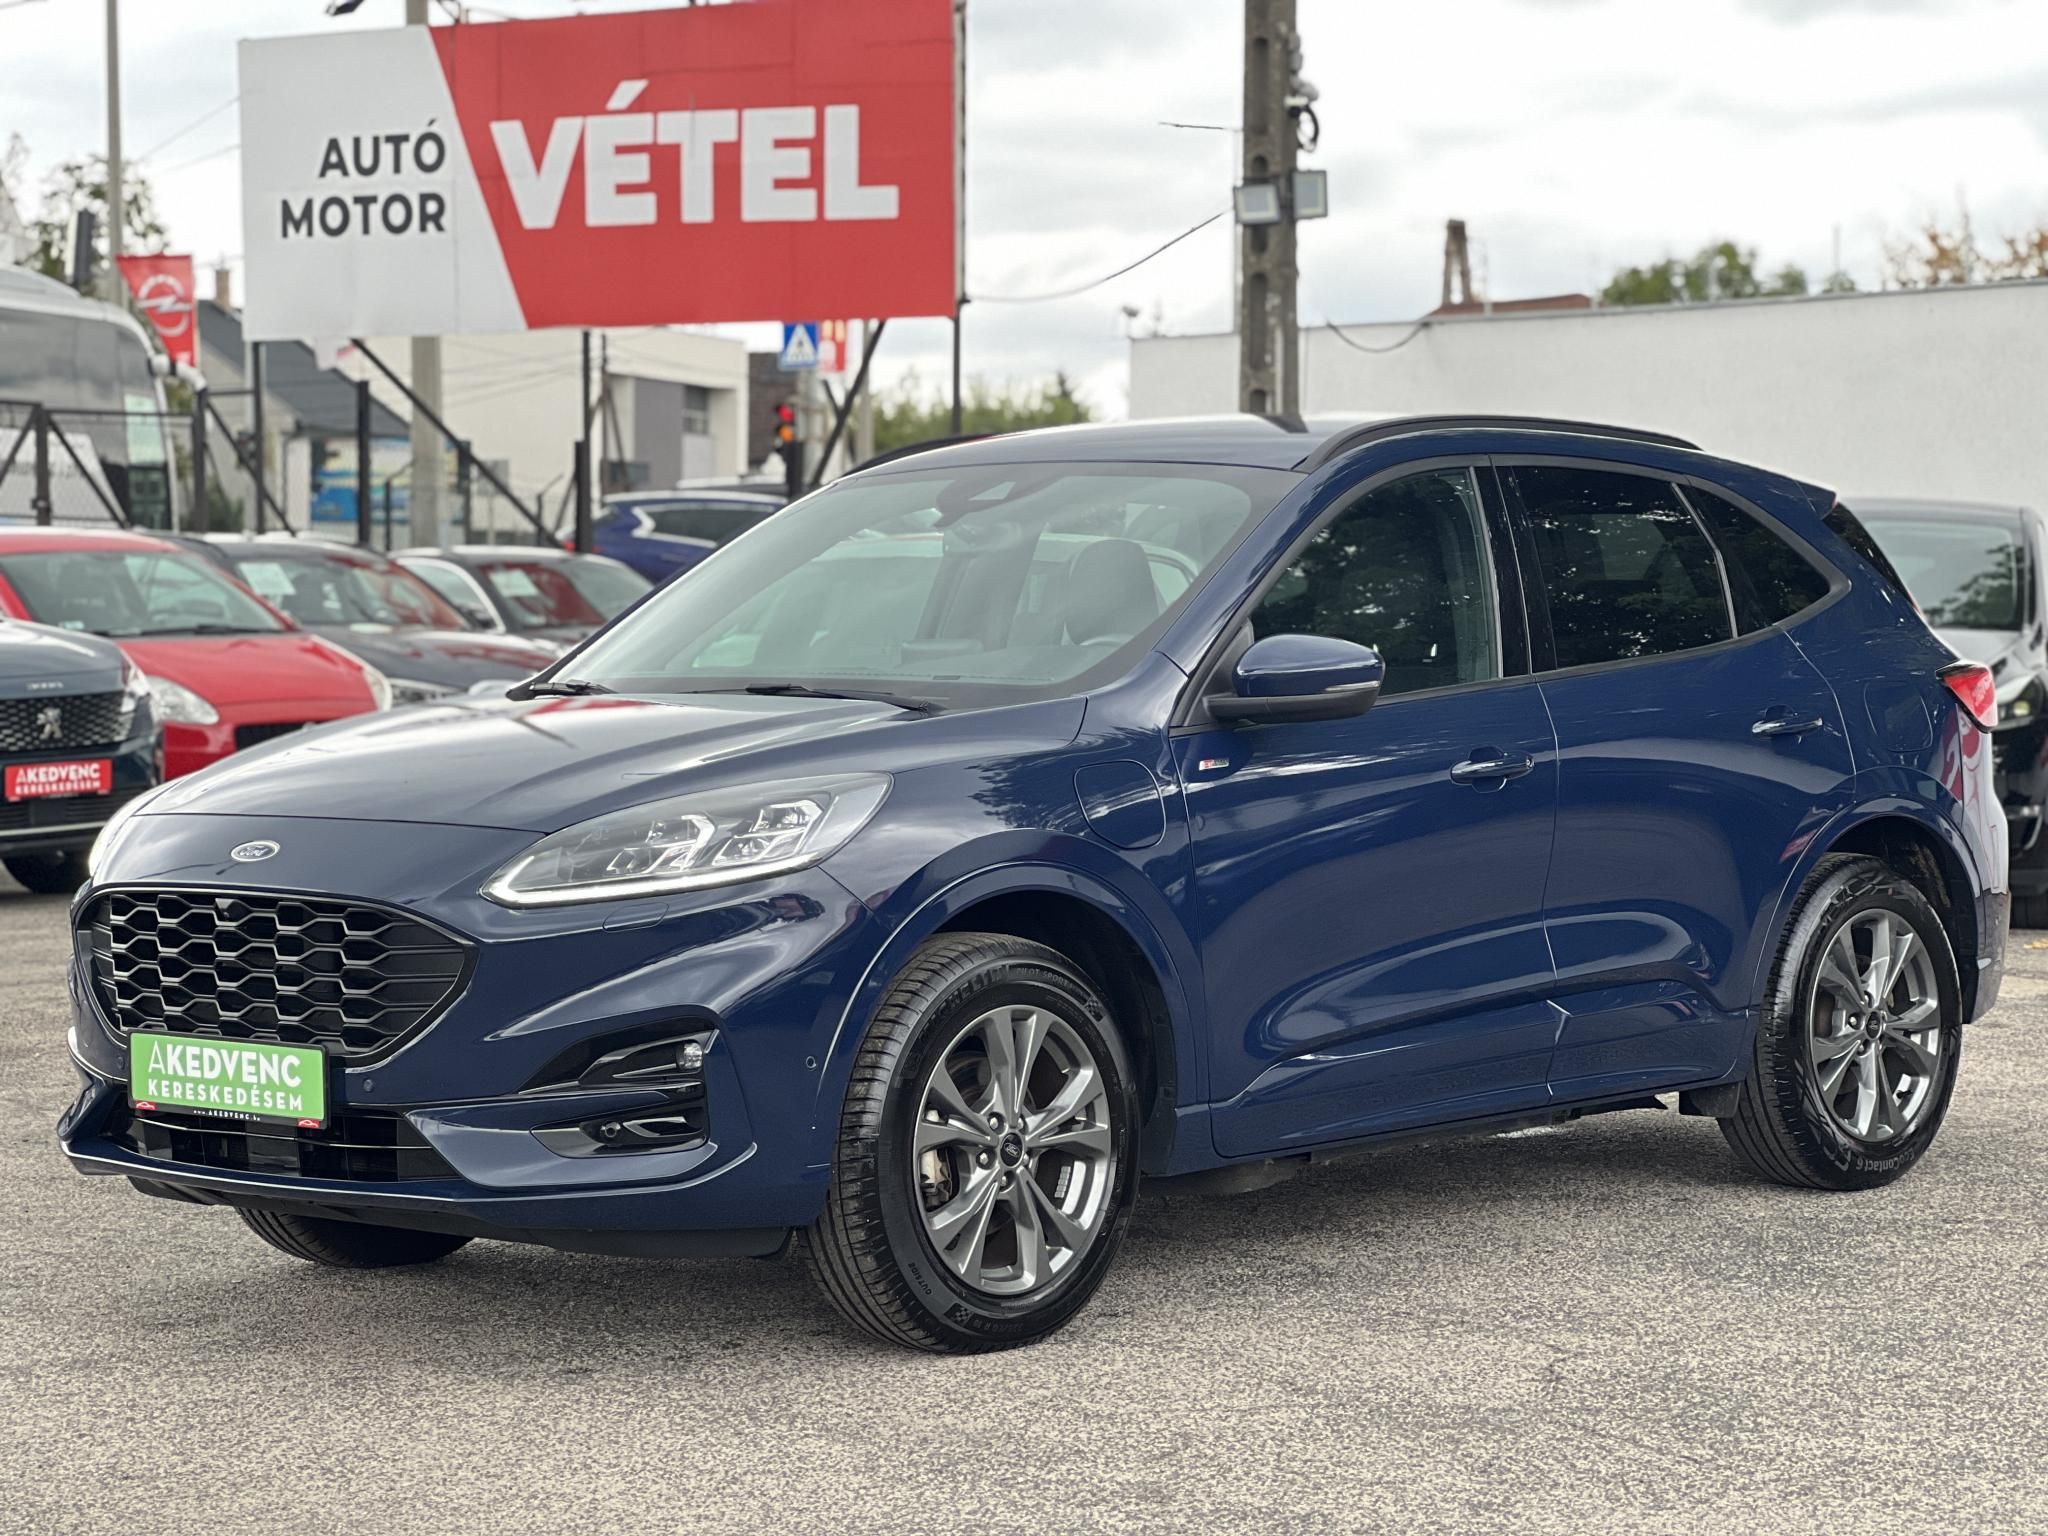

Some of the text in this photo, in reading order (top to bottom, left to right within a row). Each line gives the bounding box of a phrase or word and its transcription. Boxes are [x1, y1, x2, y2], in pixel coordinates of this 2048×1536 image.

[318, 118, 446, 179] AUTÓ
[490, 79, 899, 230] VÉTEL
[281, 192, 446, 239] MOTOR
[15, 763, 101, 784] AKEDVENC
[148, 1040, 302, 1088] AKEDVENC
[148, 1079, 304, 1111] KERESKEDÉSEM
[906, 1261, 934, 1297] OUTSIDE
